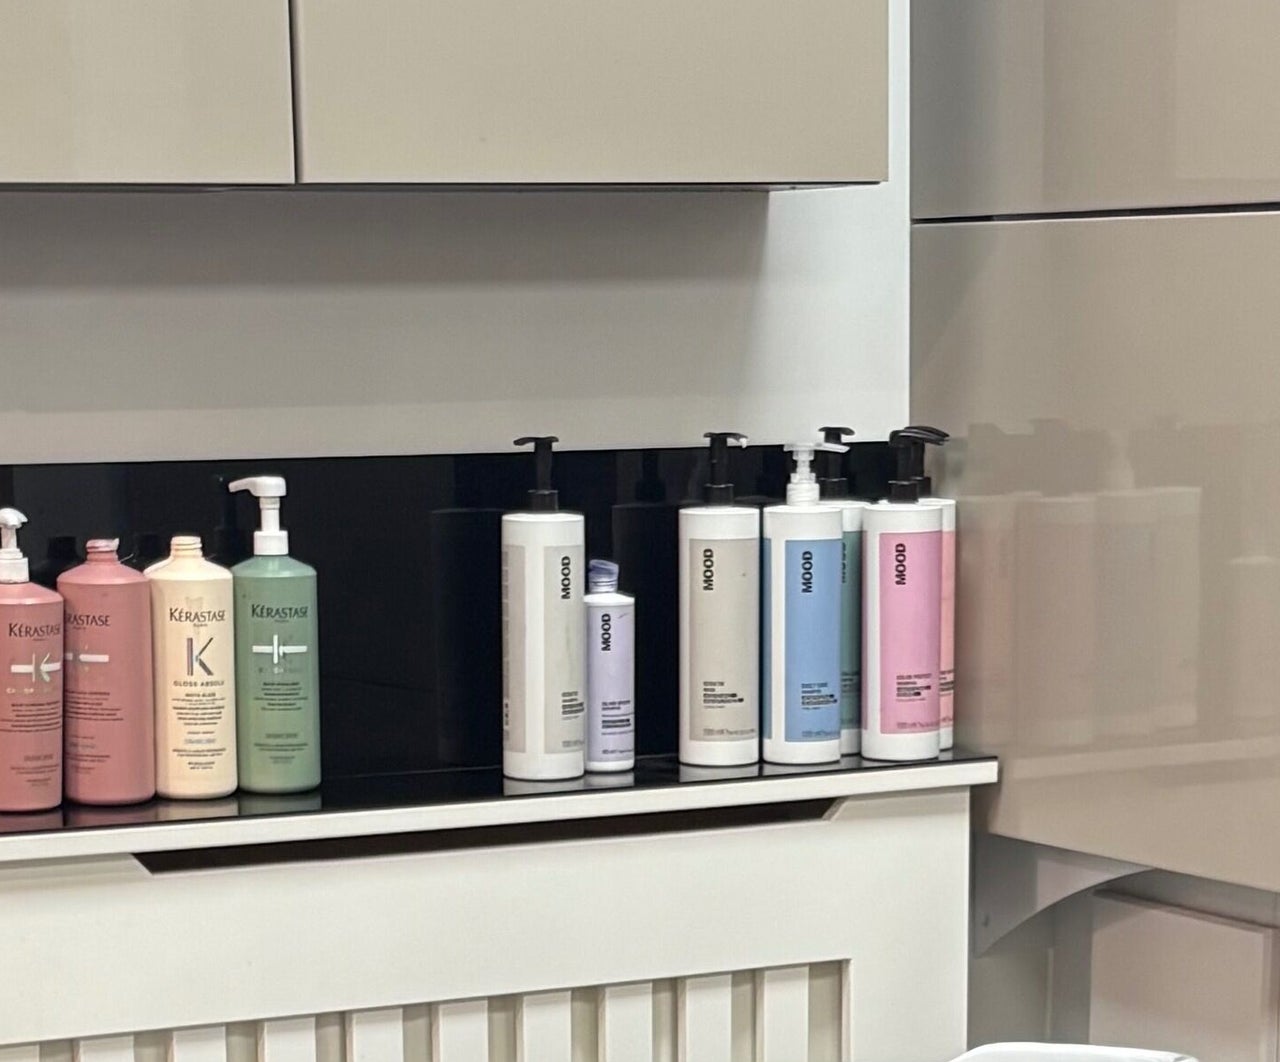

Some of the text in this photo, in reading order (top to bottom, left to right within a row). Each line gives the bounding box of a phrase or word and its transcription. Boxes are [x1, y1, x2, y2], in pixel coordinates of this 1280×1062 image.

[561, 556, 571, 600] MOOD
[703, 548, 714, 591] MOOD
[801, 550, 813, 593] MOOD
[894, 543, 907, 585] MOOD
[169, 607, 226, 622] KÉRASTASE
[601, 613, 611, 652] MOOD
